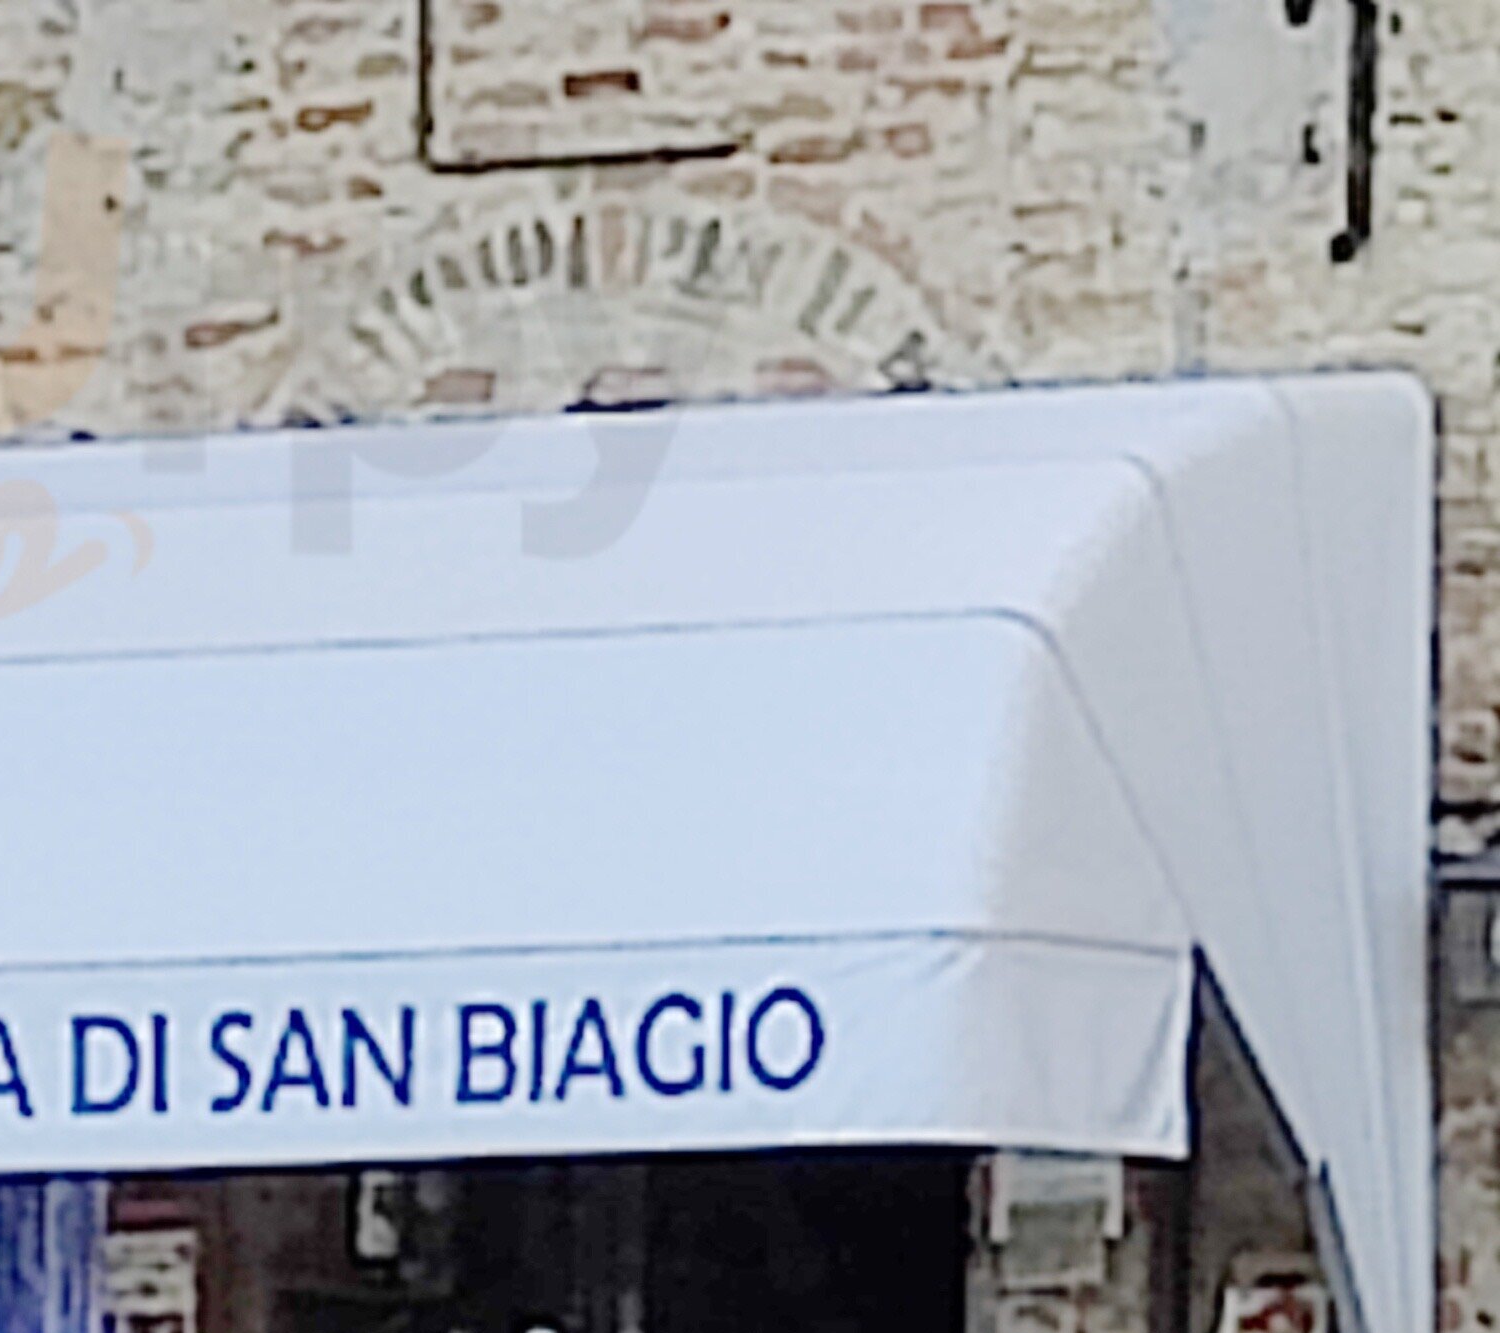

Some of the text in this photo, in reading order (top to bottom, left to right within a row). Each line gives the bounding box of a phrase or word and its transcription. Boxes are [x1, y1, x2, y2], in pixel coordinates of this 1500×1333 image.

[68, 1012, 171, 1118] DI
[209, 1004, 417, 1115] SAN
[453, 986, 826, 1106] BIAGIO
